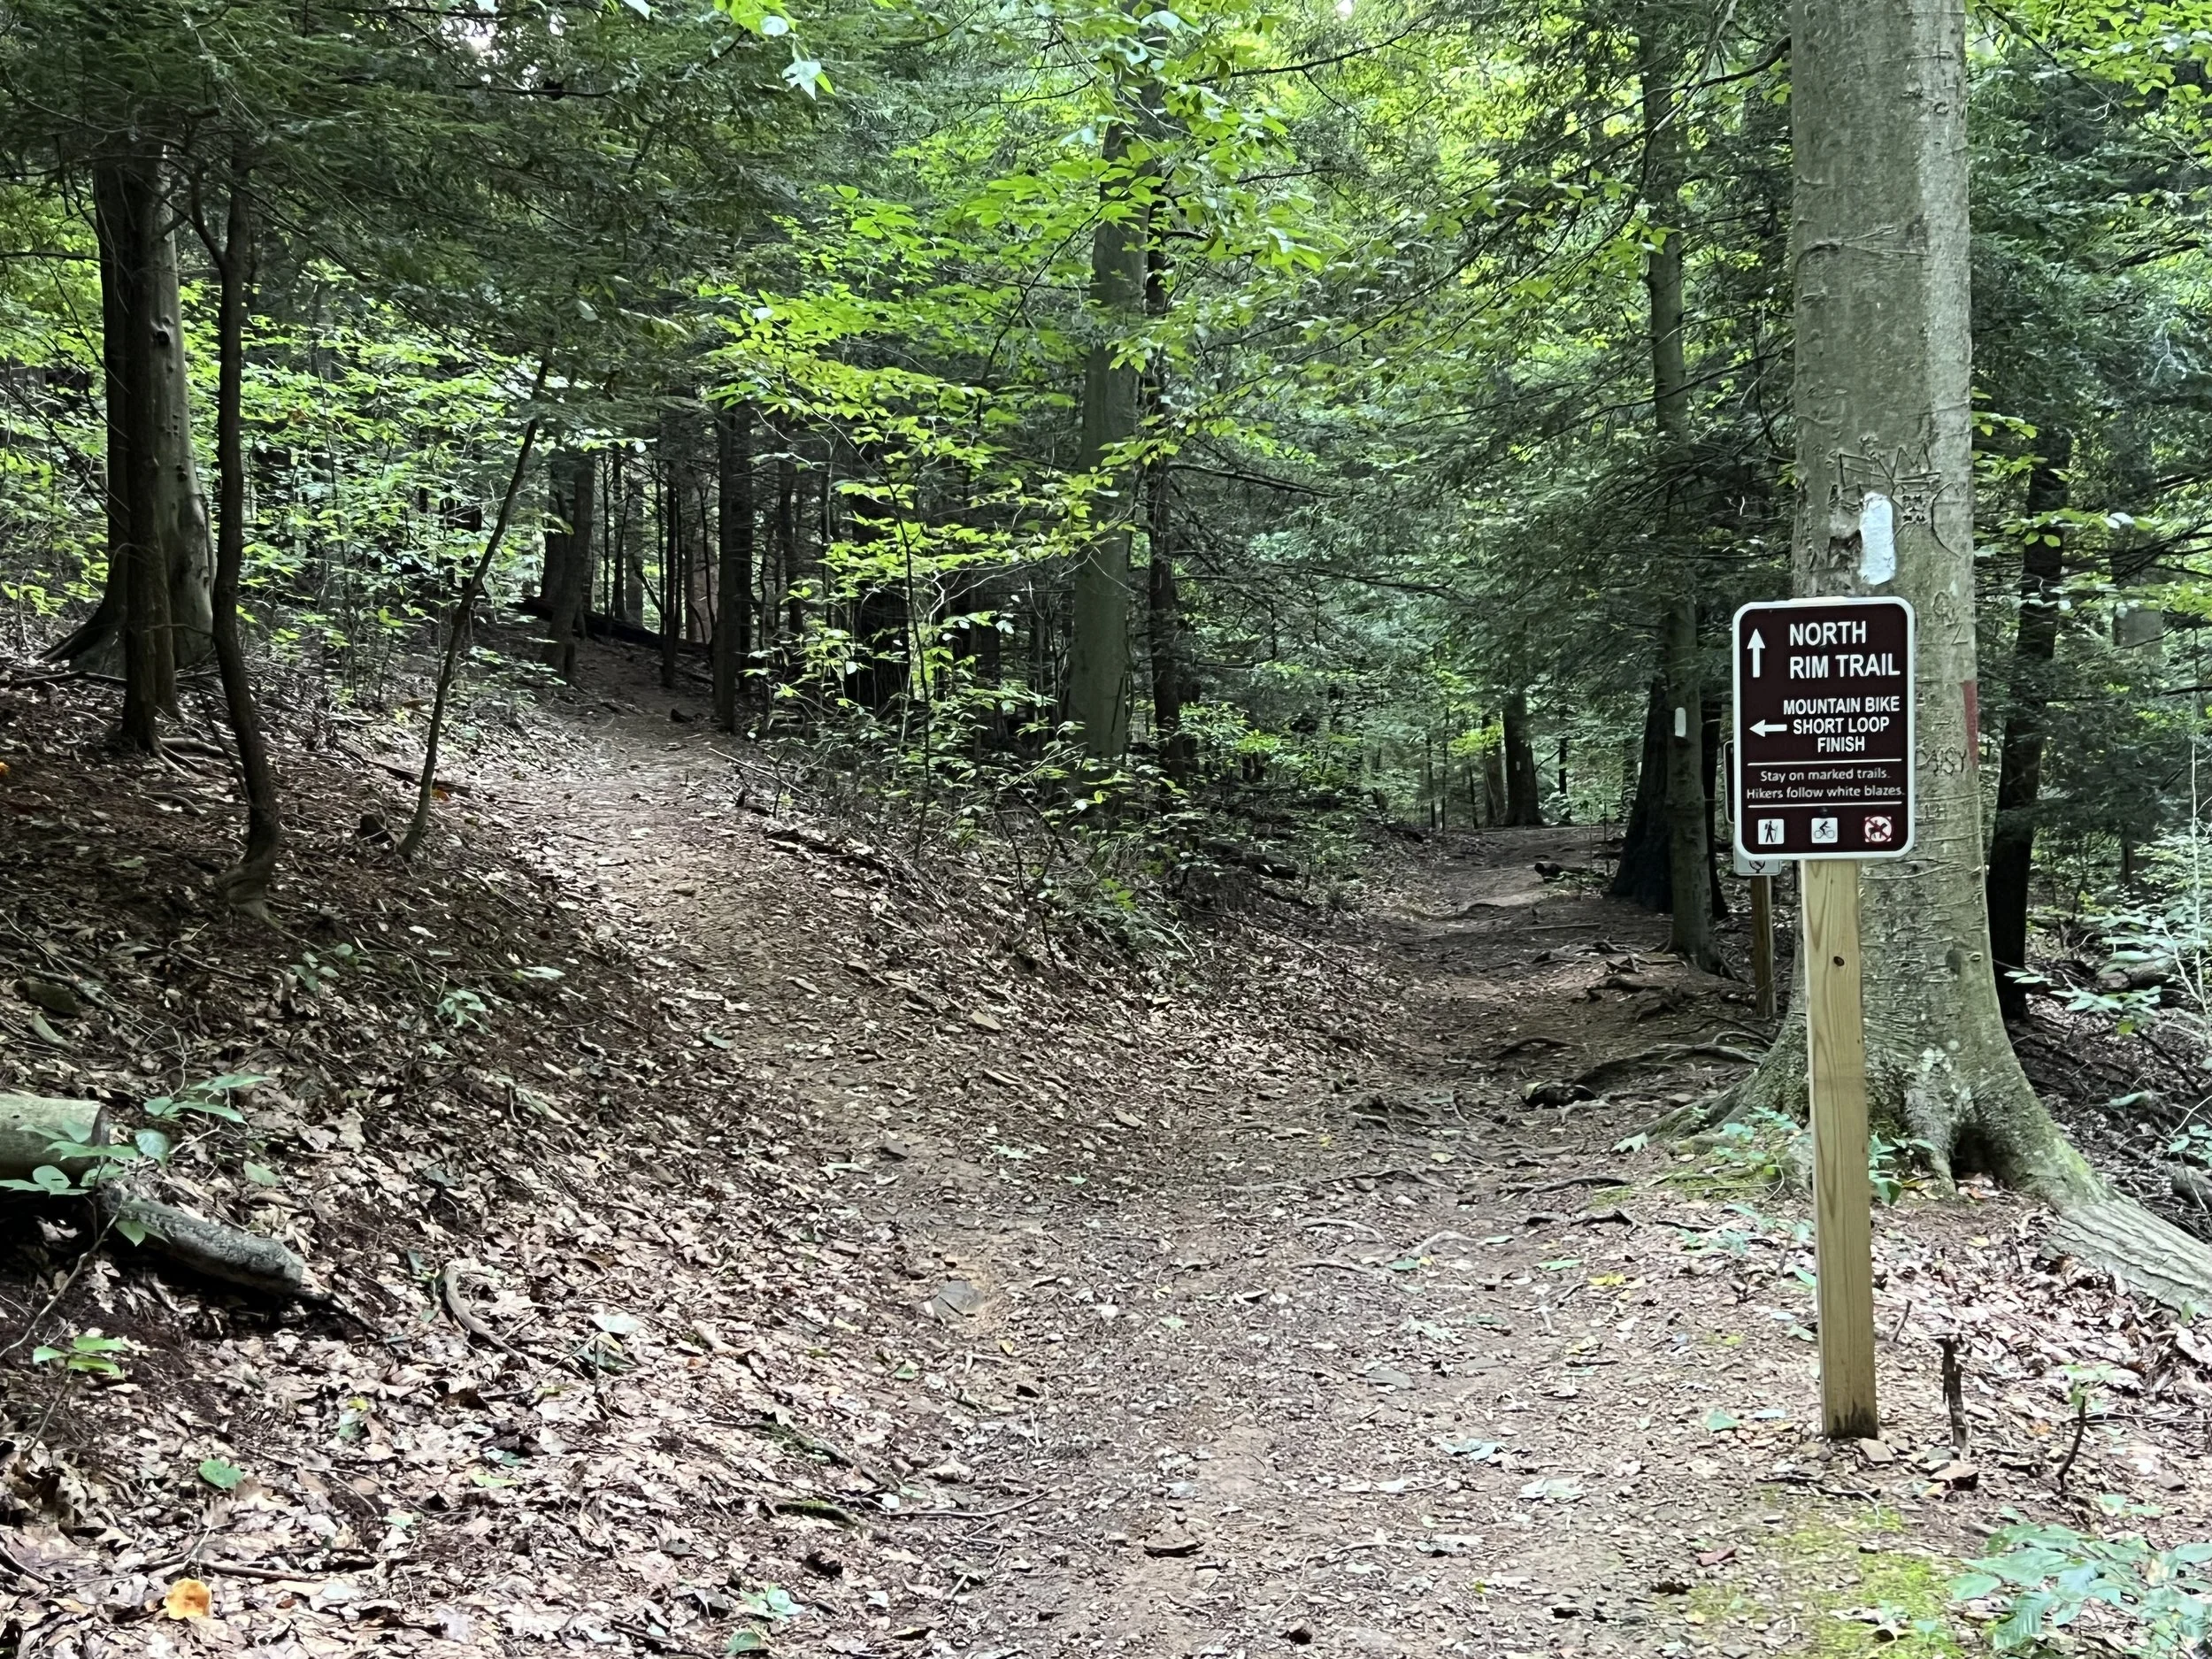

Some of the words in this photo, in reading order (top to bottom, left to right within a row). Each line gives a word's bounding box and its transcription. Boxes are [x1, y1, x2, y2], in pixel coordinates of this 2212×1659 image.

[1790, 621, 1866, 646] NORTH
[1790, 656, 1828, 679] RIM
[1835, 653, 1901, 677] TRAIL
[1784, 697, 1860, 715] MOUNTAIN
[1865, 696, 1900, 712] BIKE
[1793, 718, 1844, 734] SHORT
[1848, 717, 1889, 733] LOOP
[1818, 736, 1864, 752] FINISH
[1761, 771, 1786, 783] Stay
[1789, 772, 1804, 781] on
[1809, 768, 1854, 780] marked
[1857, 767, 1891, 779] trails.
[1747, 788, 1783, 799] Hikers
[1786, 787, 1824, 797] follow
[1827, 786, 1861, 796] white
[1864, 785, 1905, 795] blazes.
